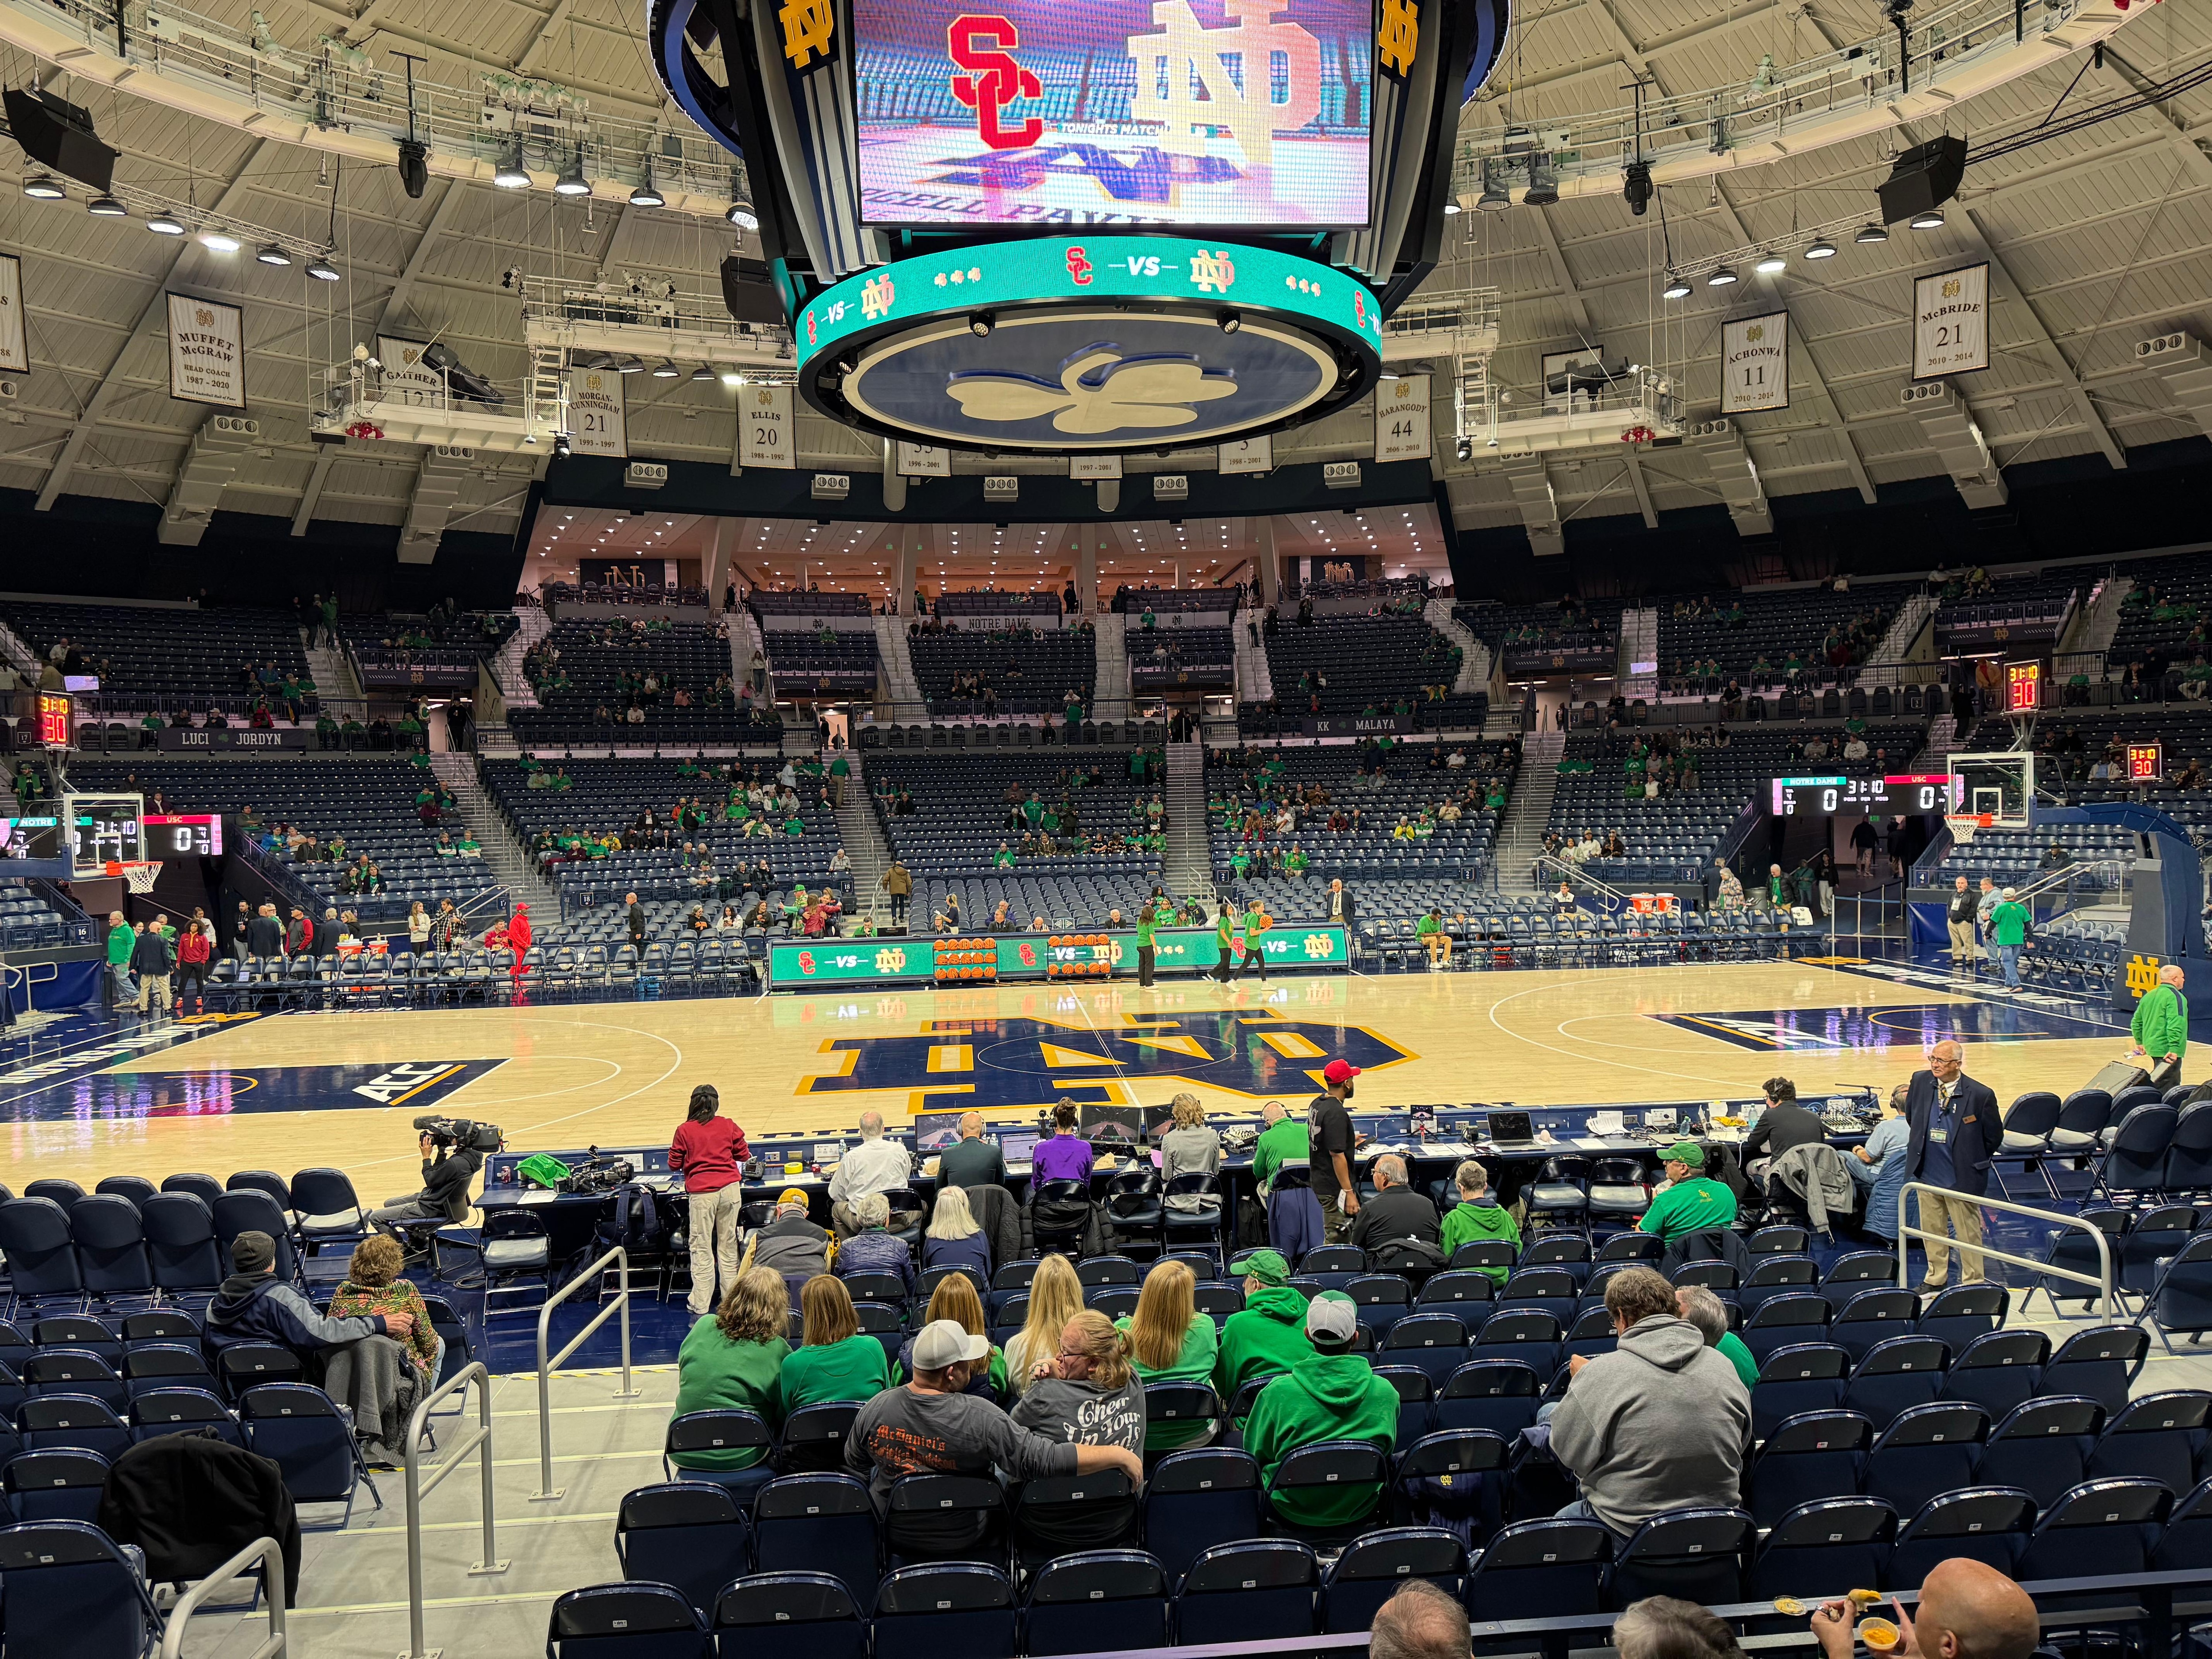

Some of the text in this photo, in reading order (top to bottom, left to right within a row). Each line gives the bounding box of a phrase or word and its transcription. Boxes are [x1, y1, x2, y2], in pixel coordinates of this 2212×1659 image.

[1921, 303, 1980, 323] McBRIDE
[178, 333, 234, 351] MUFFET
[1936, 323, 1963, 348] 21
[180, 346, 234, 362] McGRAW
[1729, 347, 1780, 364] ACHONWA
[1928, 352, 1973, 365] 2010 2014
[206, 369, 230, 377] COACH
[387, 371, 437, 387] GAITHER
[1744, 365, 1764, 386] 11
[186, 376, 229, 389] 1987 2020
[578, 392, 613, 402] MORGAN-
[1758, 392, 1774, 400] 2014
[571, 400, 620, 414] CUNNINGHAM
[1379, 403, 1427, 418] HARANGODY
[585, 414, 605, 432] 21
[751, 411, 781, 421] ELLIS
[757, 428, 777, 445] 20
[1391, 420, 1412, 438] 44
[969, 618, 1031, 629] NOTRE DAME
[2010, 665, 2038, 682] 31:10
[2013, 681, 2035, 707] 30
[43, 697, 68, 714] 31:10
[46, 714, 66, 742] 30
[1317, 719, 1395, 732] KK MALAYA
[182, 733, 281, 745] LUCI JORDYN
[2130, 749, 2156, 760] 31:10
[2135, 760, 2152, 774] 30
[1848, 780, 1884, 794] 31:10
[1824, 789, 1837, 811] 0
[1920, 787, 1934, 809] 0
[1786, 804, 1793, 815] 0
[177, 827, 191, 851] 0
[201, 844, 208, 854] 0
[95, 1024, 215, 1050] DAME
[353, 1063, 453, 1102] ACC
[1078, 1397, 1129, 1427] Cheer
[1101, 1412, 1141, 1440] Your
